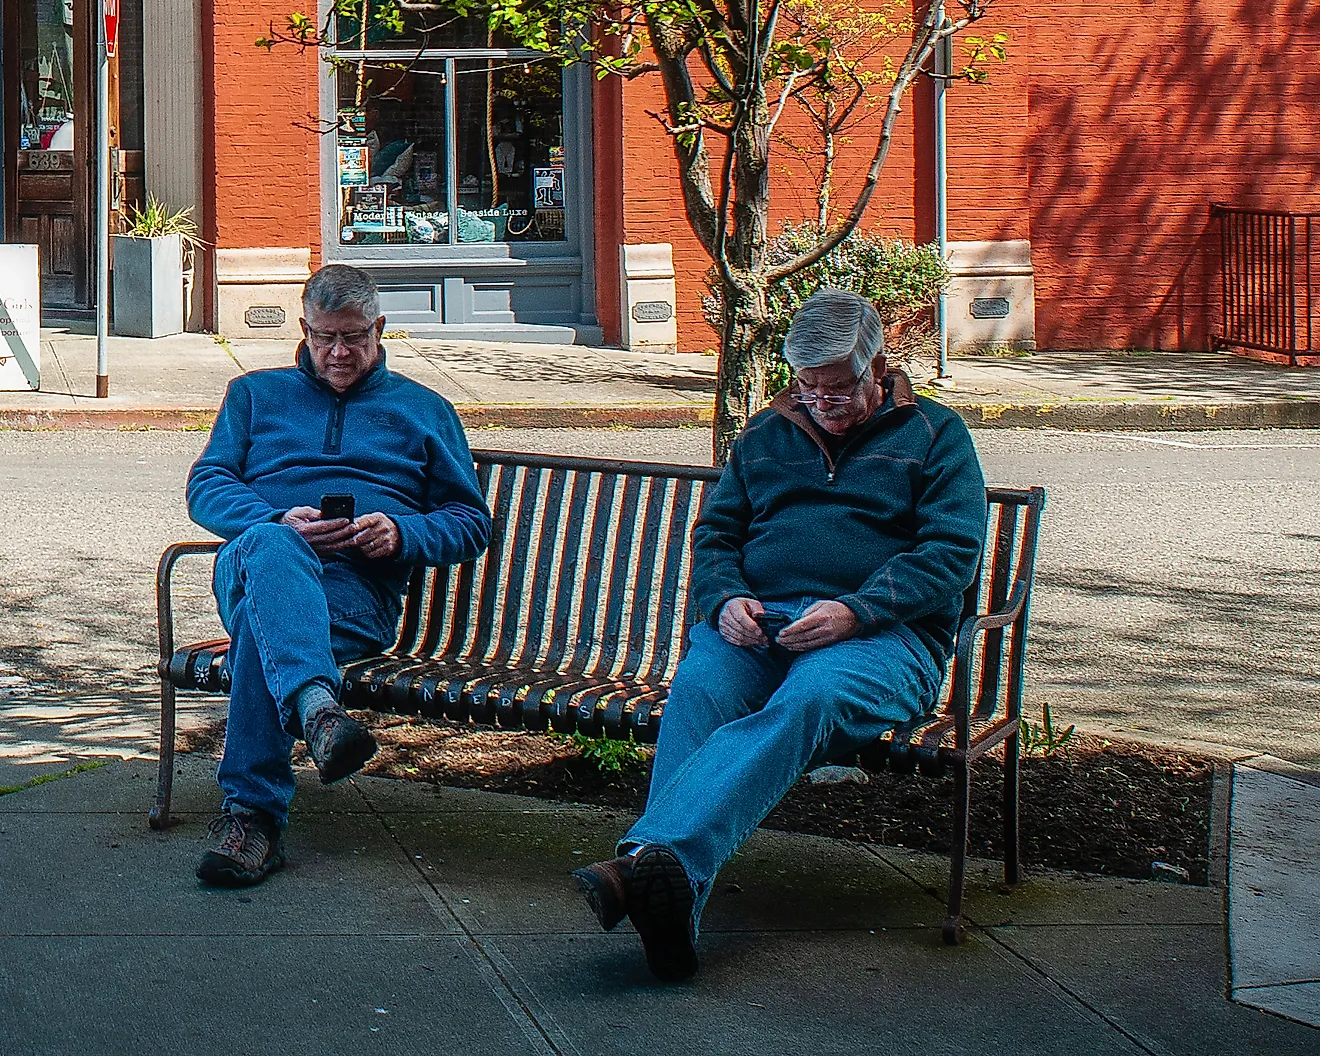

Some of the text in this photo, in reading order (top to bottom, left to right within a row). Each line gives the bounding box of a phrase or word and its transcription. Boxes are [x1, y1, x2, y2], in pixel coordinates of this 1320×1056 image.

[29, 154, 60, 169] 639
[460, 208, 499, 217] Seaside
[501, 208, 528, 217] Luxe
[423, 687, 512, 707] NEED
[556, 703, 591, 720] IS
